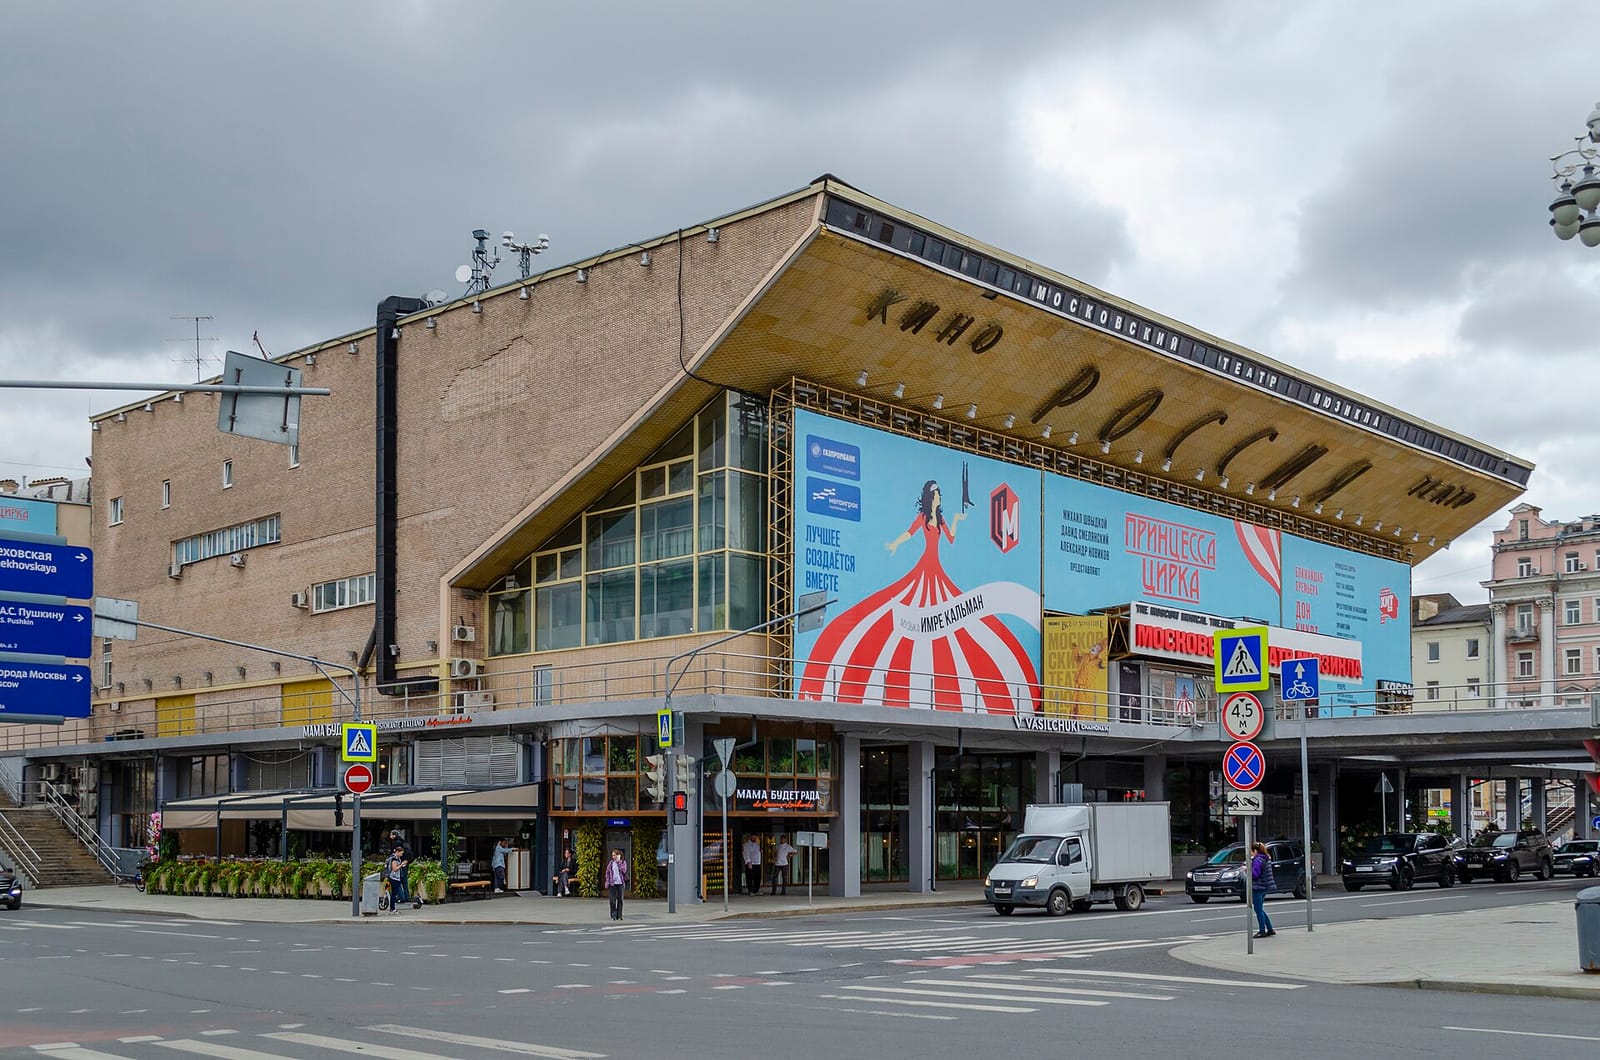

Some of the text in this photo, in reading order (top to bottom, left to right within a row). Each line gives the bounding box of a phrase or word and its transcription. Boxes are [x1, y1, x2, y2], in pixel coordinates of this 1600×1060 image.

[1036, 284, 1382, 428] МОСКОВСКИЙ ТЕАТР МЮЗИКЛА
[867, 287, 1004, 355] КИНО
[1030, 365, 1374, 503] РОССИЯ
[805, 525, 841, 548] ЛУЧШЕЕ
[1125, 516, 1216, 567] ПРИНЦЕССА
[805, 547, 856, 572] СОЗДАЁТСЯ
[805, 570, 839, 592] ВМЕСТЕ
[1142, 558, 1200, 600] ЦИРКА
[18, 608, 64, 622] Пушкину
[920, 613, 944, 633] ИМРЕ
[944, 594, 984, 626] КАЛЬМАН
[1136, 604, 1149, 615] THE
[1150, 607, 1179, 620] MOSCOW
[1181, 612, 1208, 625] MUSICAL
[1296, 600, 1311, 620] ДОН
[7, 618, 34, 626] Pushkin
[29, 670, 67, 681] Москвы
[1231, 703, 1253, 718] 4,5
[302, 723, 342, 737] МАМА БУД
[1025, 717, 1080, 732] VASILCHUKI
[736, 789, 820, 801] МАМА БУДЕТ РАДА
